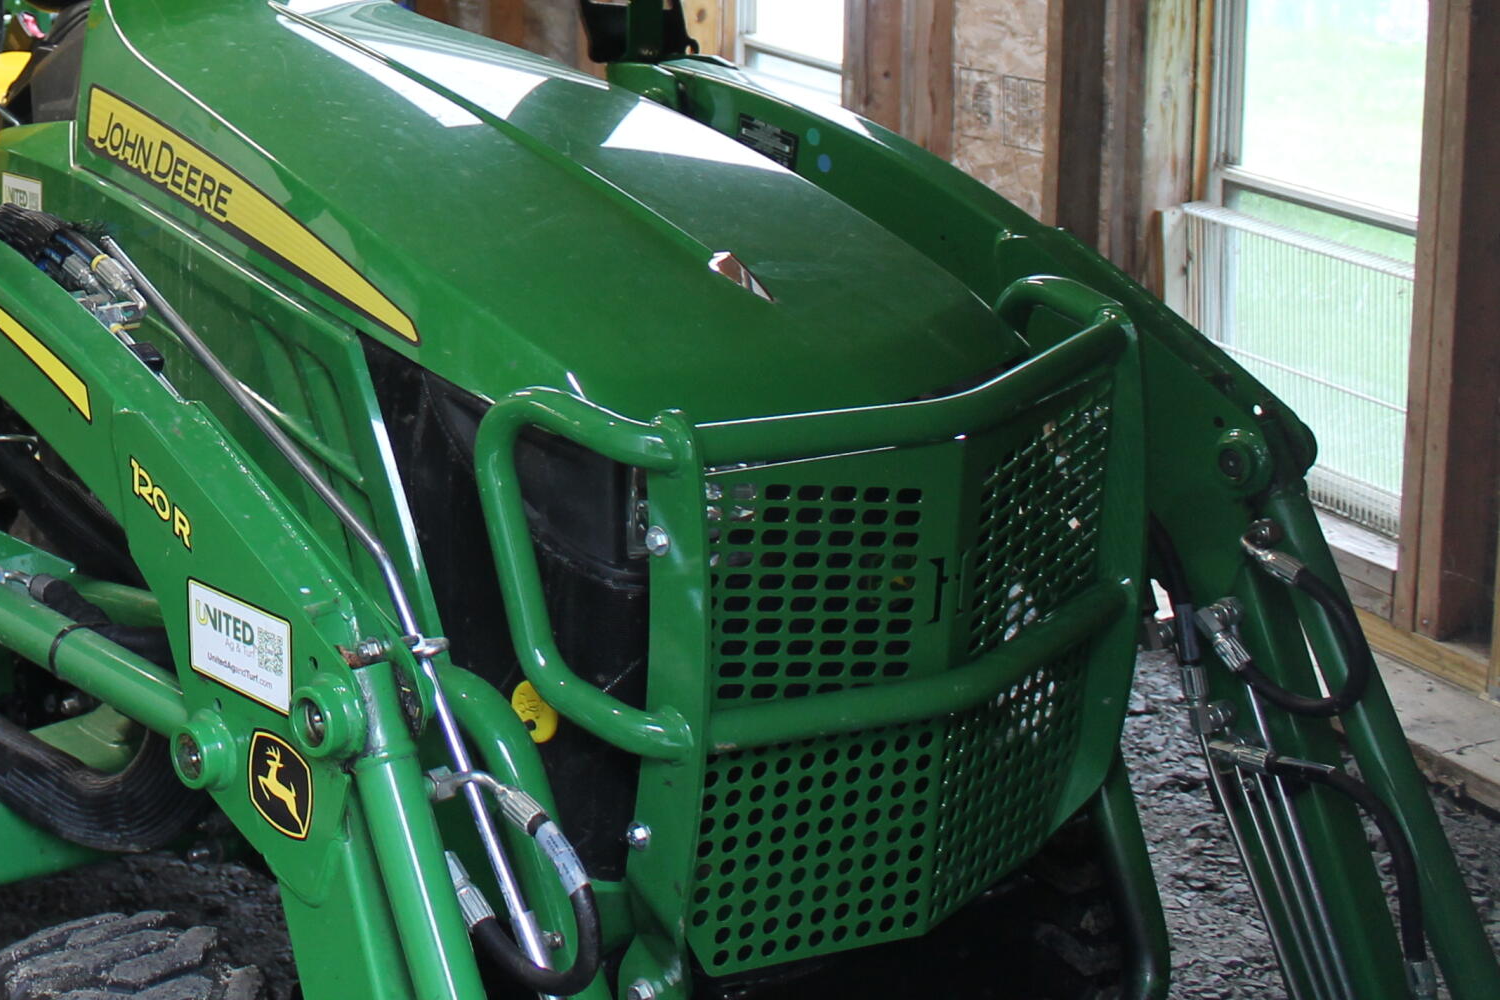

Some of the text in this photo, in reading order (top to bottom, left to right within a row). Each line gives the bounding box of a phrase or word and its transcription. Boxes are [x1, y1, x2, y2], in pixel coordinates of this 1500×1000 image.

[97, 112, 233, 218] JOHN DEERE
[195, 599, 255, 646] UNITED
